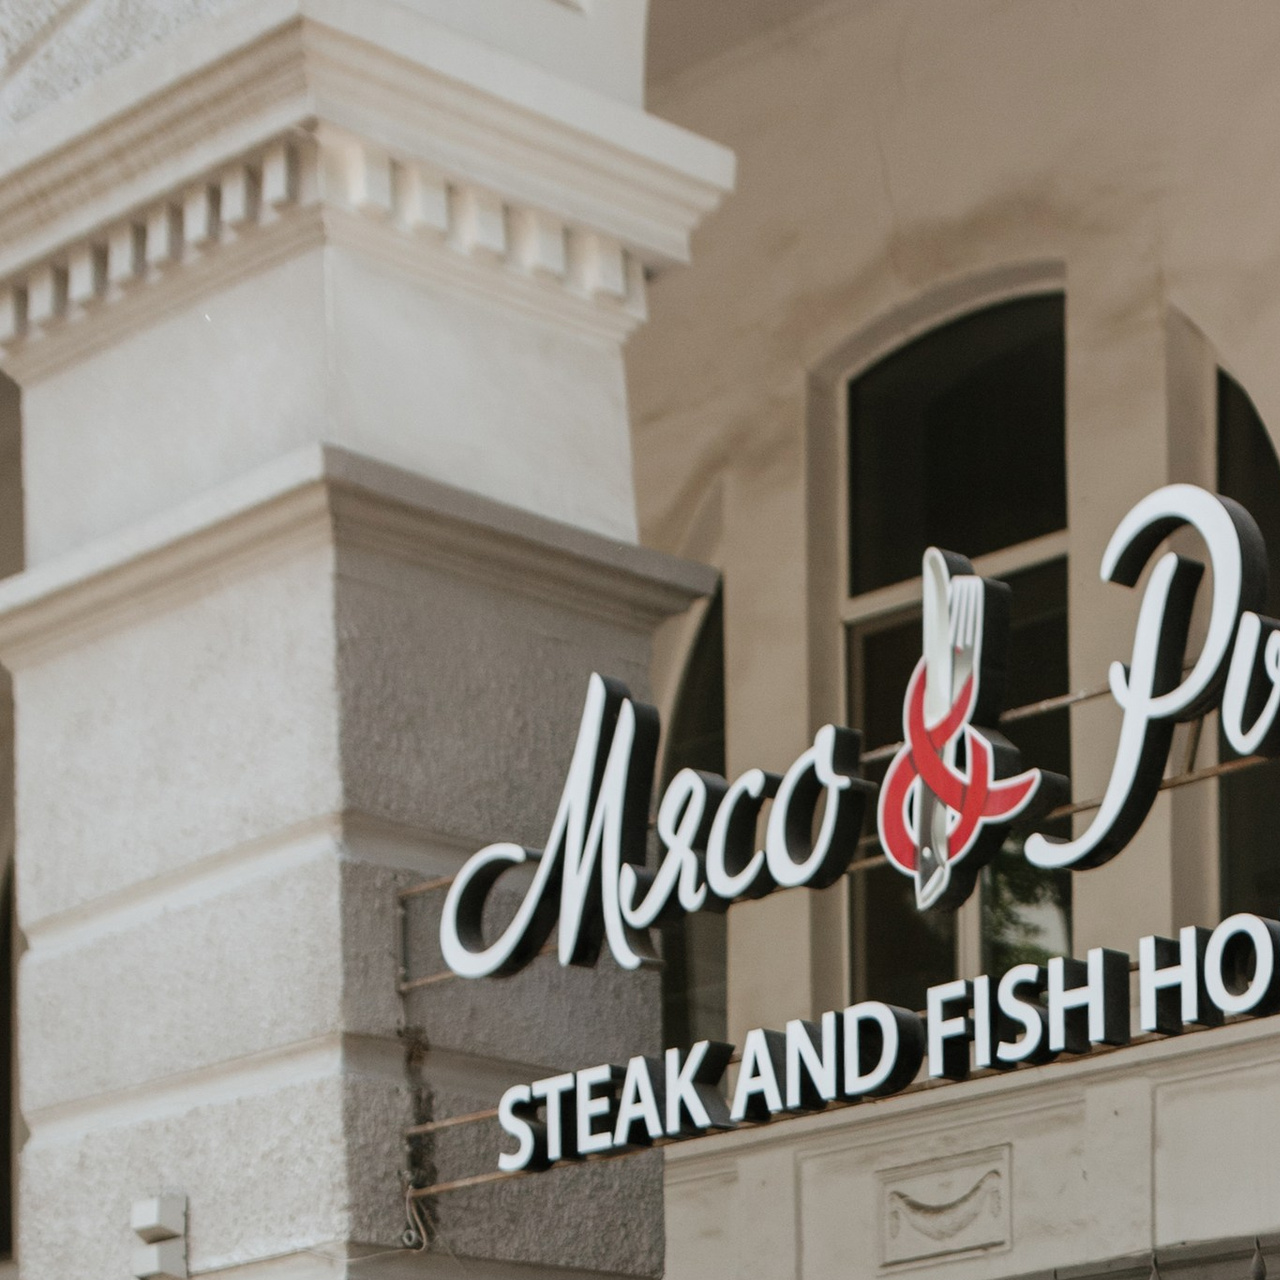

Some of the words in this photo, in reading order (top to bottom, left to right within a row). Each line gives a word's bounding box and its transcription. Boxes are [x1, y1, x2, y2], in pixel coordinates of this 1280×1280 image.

[439, 671, 852, 979] Мясо
[498, 1039, 712, 1172] STEAK
[729, 1000, 899, 1123] AND
[926, 946, 1106, 1077] FISH
